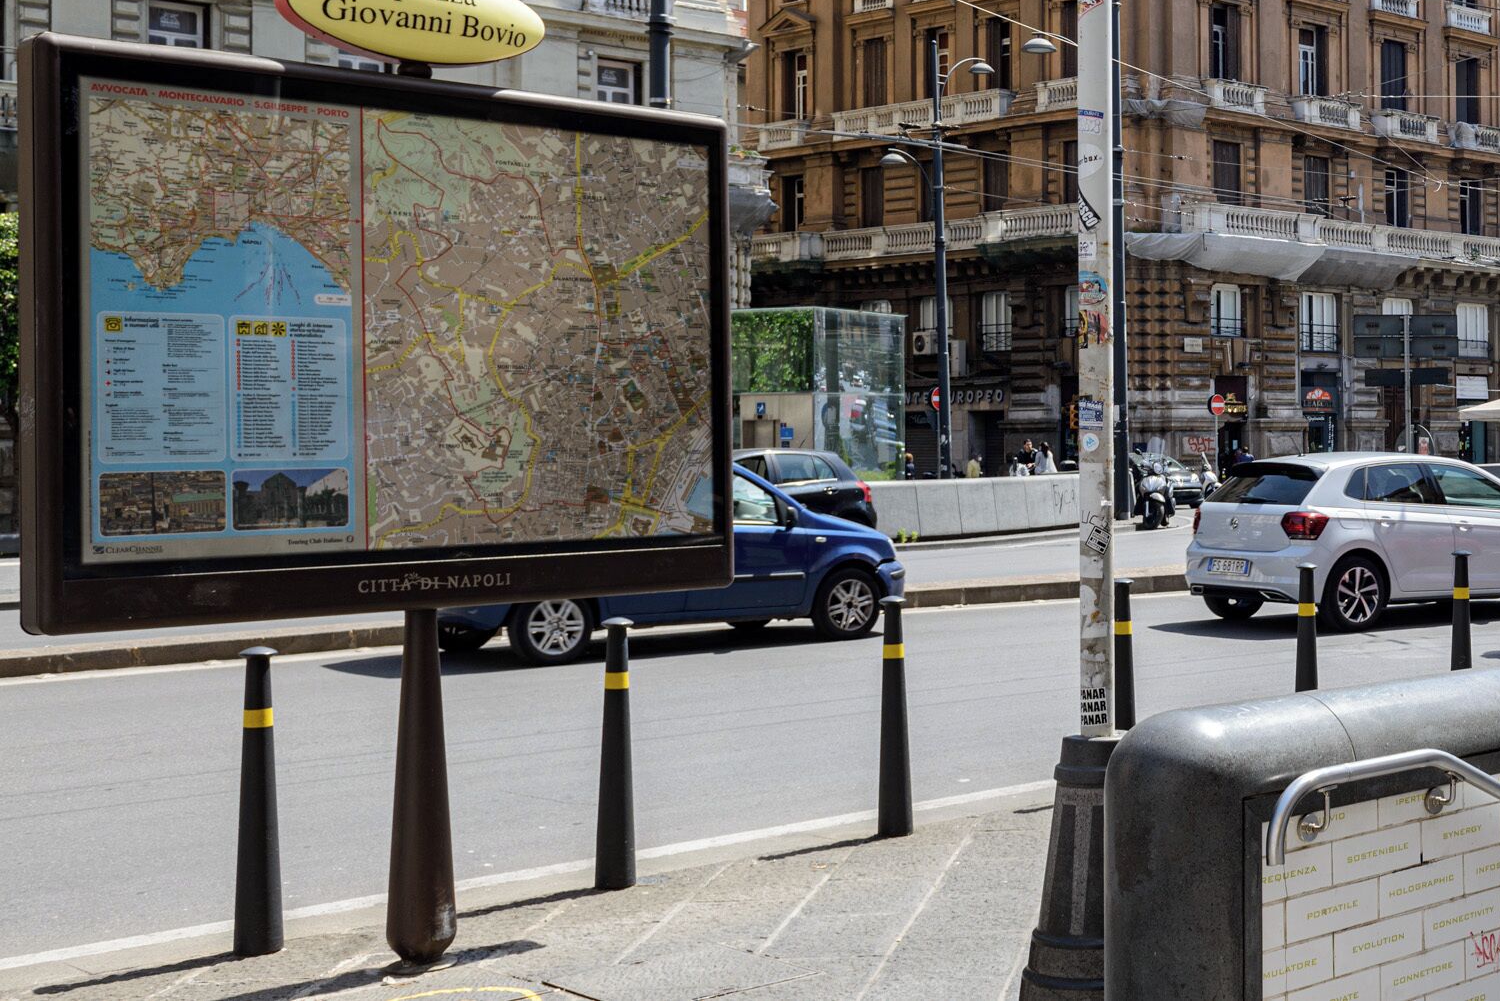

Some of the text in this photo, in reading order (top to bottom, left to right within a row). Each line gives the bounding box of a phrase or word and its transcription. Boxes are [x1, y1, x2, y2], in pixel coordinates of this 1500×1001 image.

[460, 15, 527, 49] Bovio
[91, 82, 148, 97] AVVOCATA
[158, 90, 245, 107] MONTECALVARIO
[317, 107, 350, 118] PORTO
[420, 577, 440, 590] DI
[447, 572, 511, 589] NAPOLI
[1442, 825, 1483, 840] SYNERGY
[1347, 842, 1409, 864] SOSTENIBILE
[1262, 865, 1318, 884] REQUENZA
[1389, 874, 1456, 898] HOLOGRAPHIC
[1307, 899, 1360, 920] PORTATILE
[1433, 905, 1495, 931] CONNECTIVITY
[1352, 932, 1406, 954] EVOLUTION
[1263, 957, 1318, 980] MULATORE
[1394, 960, 1454, 986] CONNETTORE
